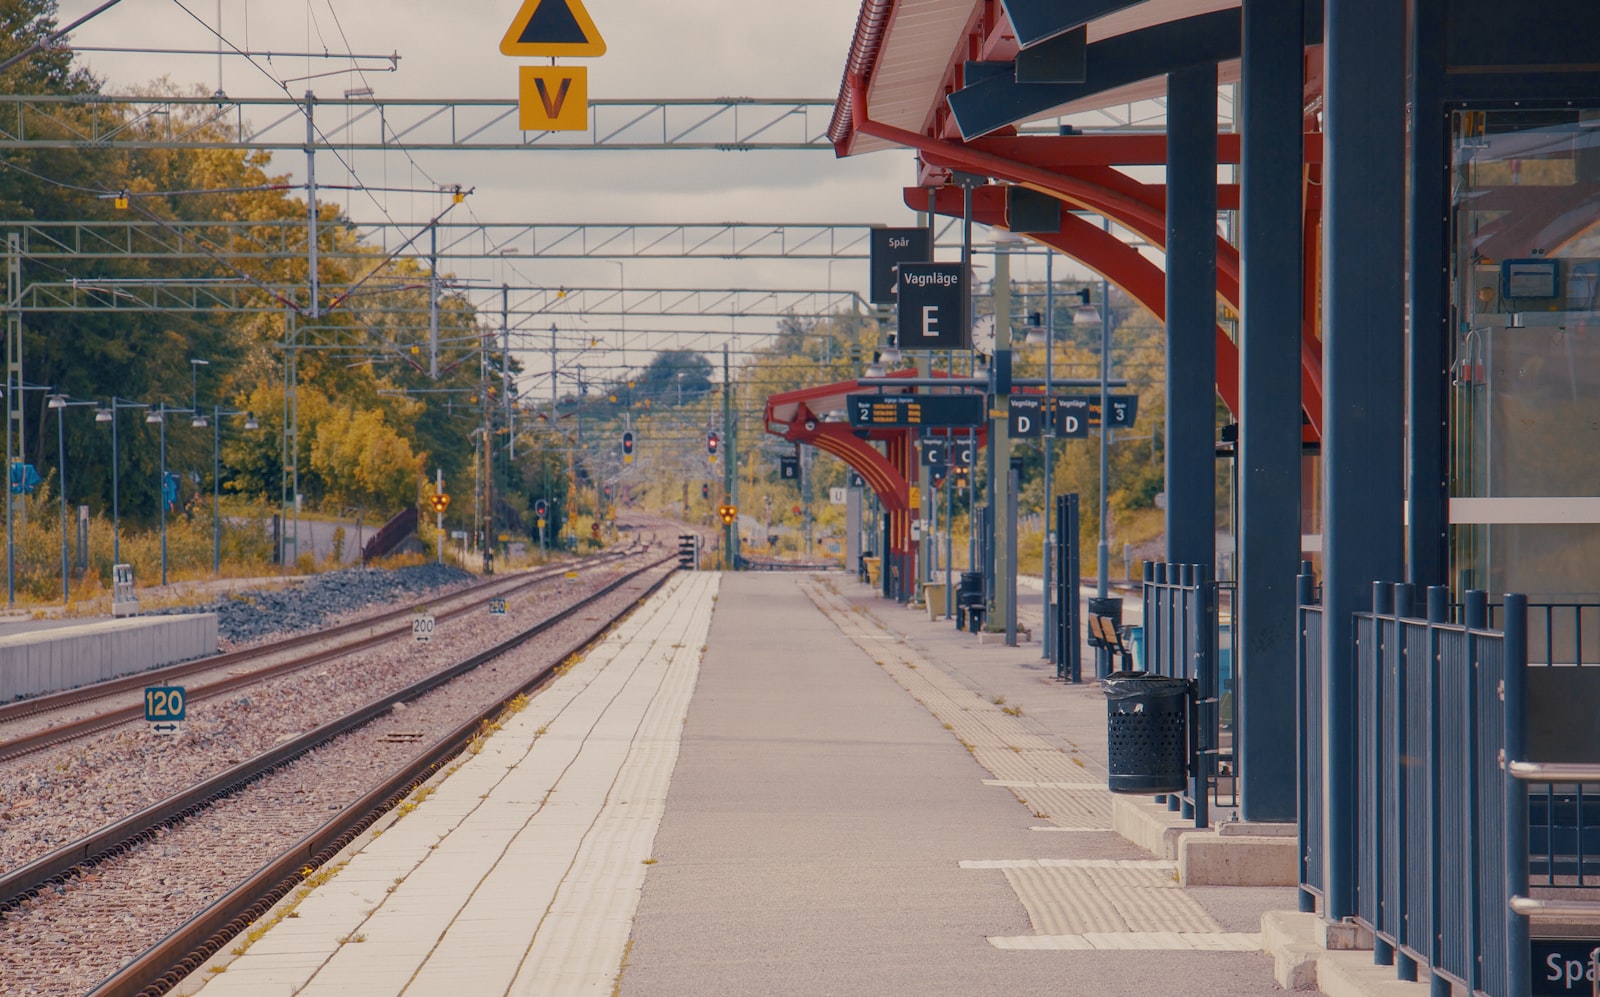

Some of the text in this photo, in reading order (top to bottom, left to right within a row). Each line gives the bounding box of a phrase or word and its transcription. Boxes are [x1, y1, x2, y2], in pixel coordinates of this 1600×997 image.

[533, 77, 572, 119] V
[888, 237, 909, 248] Spår
[904, 272, 958, 287] Vagnläge
[922, 305, 939, 336] E
[860, 408, 869, 420] 2
[1116, 408, 1125, 421] 3
[1018, 416, 1031, 433] D
[1065, 416, 1079, 433] D
[928, 450, 937, 463] C
[786, 467, 793, 477] B
[855, 477, 862, 485] A
[835, 491, 842, 501] U
[414, 619, 433, 632] 200
[147, 690, 183, 716] 120
